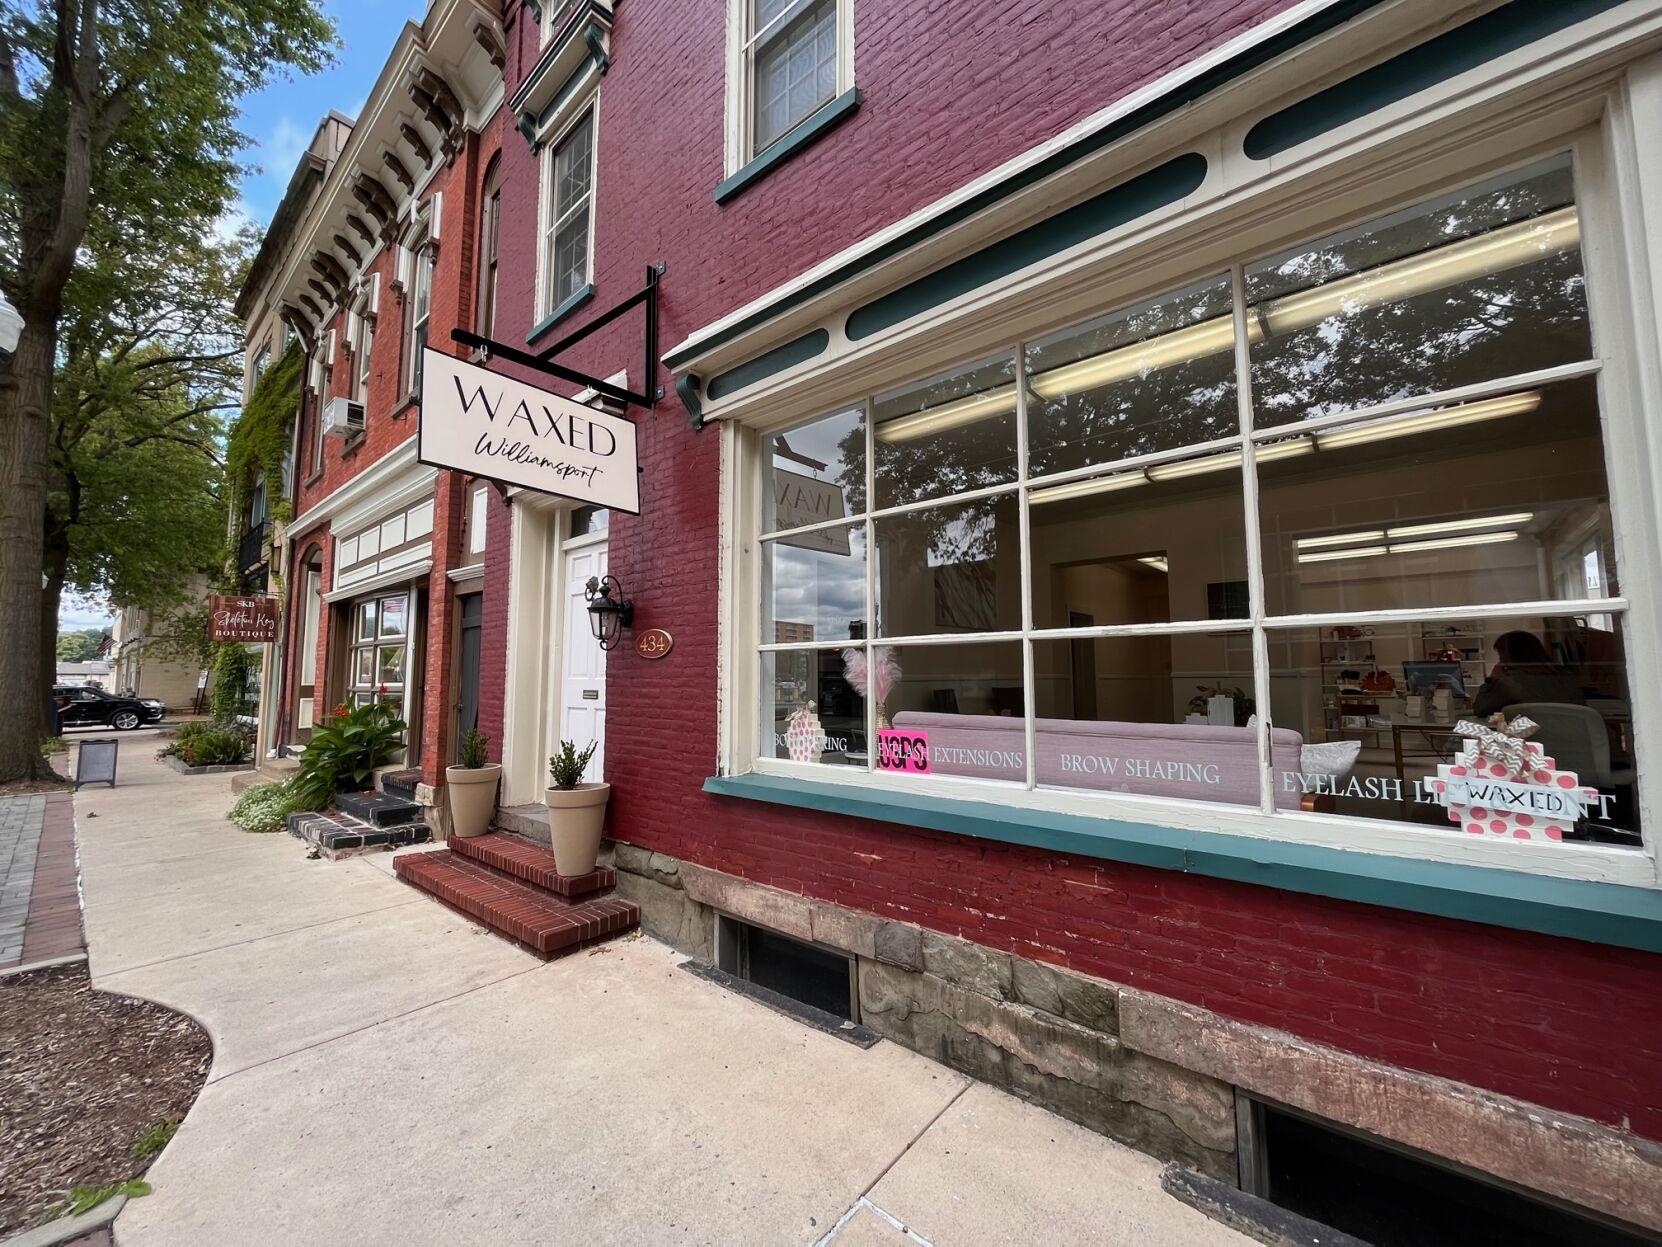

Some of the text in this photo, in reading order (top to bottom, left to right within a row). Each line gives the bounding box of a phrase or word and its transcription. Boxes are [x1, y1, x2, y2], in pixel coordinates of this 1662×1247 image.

[453, 375, 616, 457] WAXED
[474, 432, 604, 488] Williamsport
[236, 600, 256, 608] SKB
[213, 610, 275, 630] Skeleton Key
[215, 629, 275, 638] BOUTIQUE
[640, 635, 666, 652] 434
[877, 735, 928, 771] USPS
[877, 742, 1023, 769] EYELASH EXTENSIONS
[1060, 754, 1221, 785] BROW SHAPING
[1282, 771, 1404, 802] EYELASH
[1465, 781, 1563, 812] WAXED
